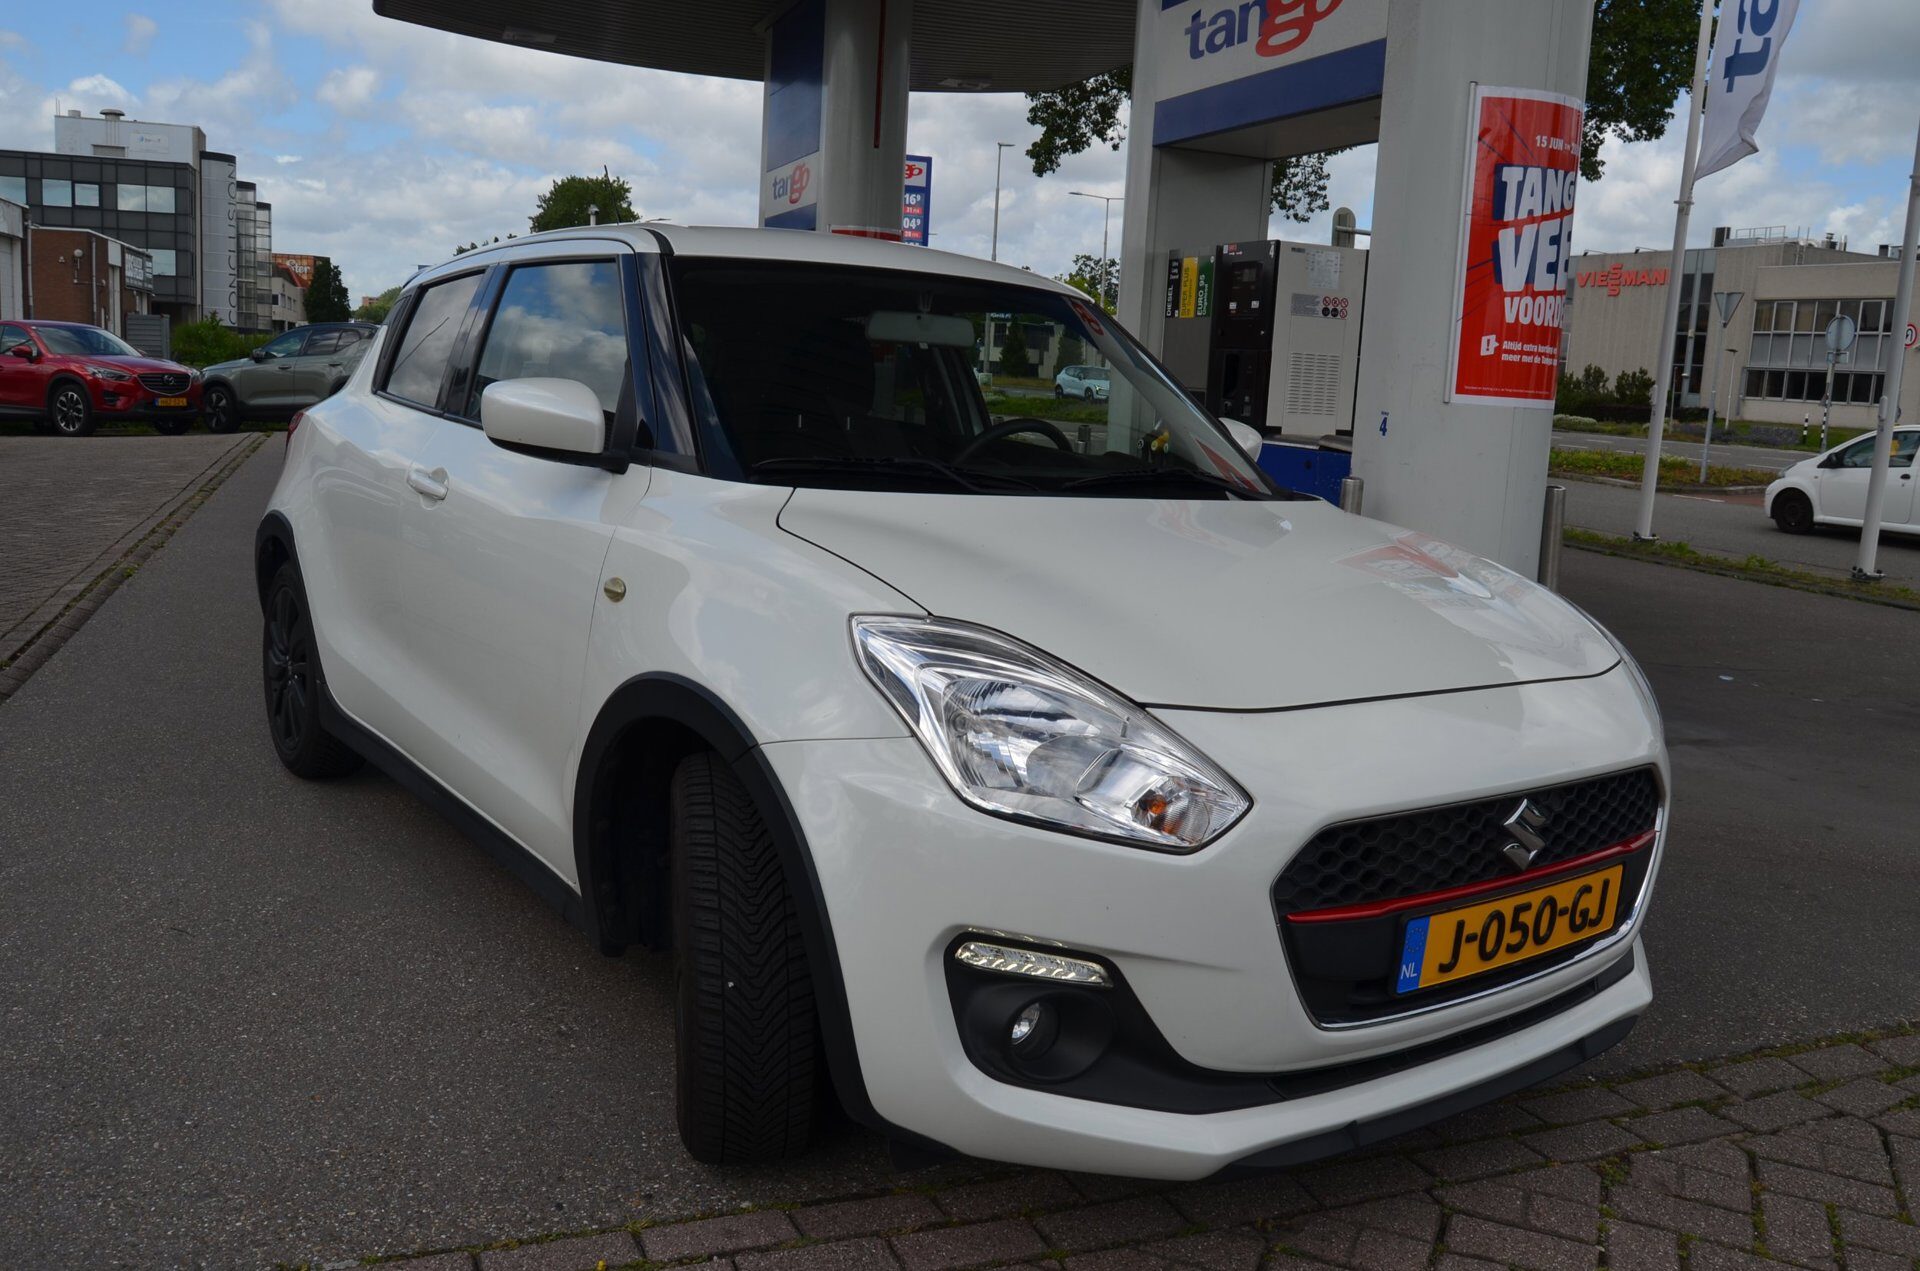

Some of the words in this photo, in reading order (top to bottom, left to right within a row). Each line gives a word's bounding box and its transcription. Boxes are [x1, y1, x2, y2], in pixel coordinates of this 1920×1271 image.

[1535, 135, 1547, 148] 15
[1549, 138, 1563, 152] JUN
[772, 163, 810, 204] tango
[1166, 284, 1174, 317] DIESEL
[1196, 289, 1204, 316] EURO
[1502, 340, 1522, 352] Altijd
[1501, 353, 1520, 362] meer
[1379, 417, 1388, 437] 4
[1438, 878, 1610, 974] J-050-GJ
[1400, 962, 1418, 978] NL
